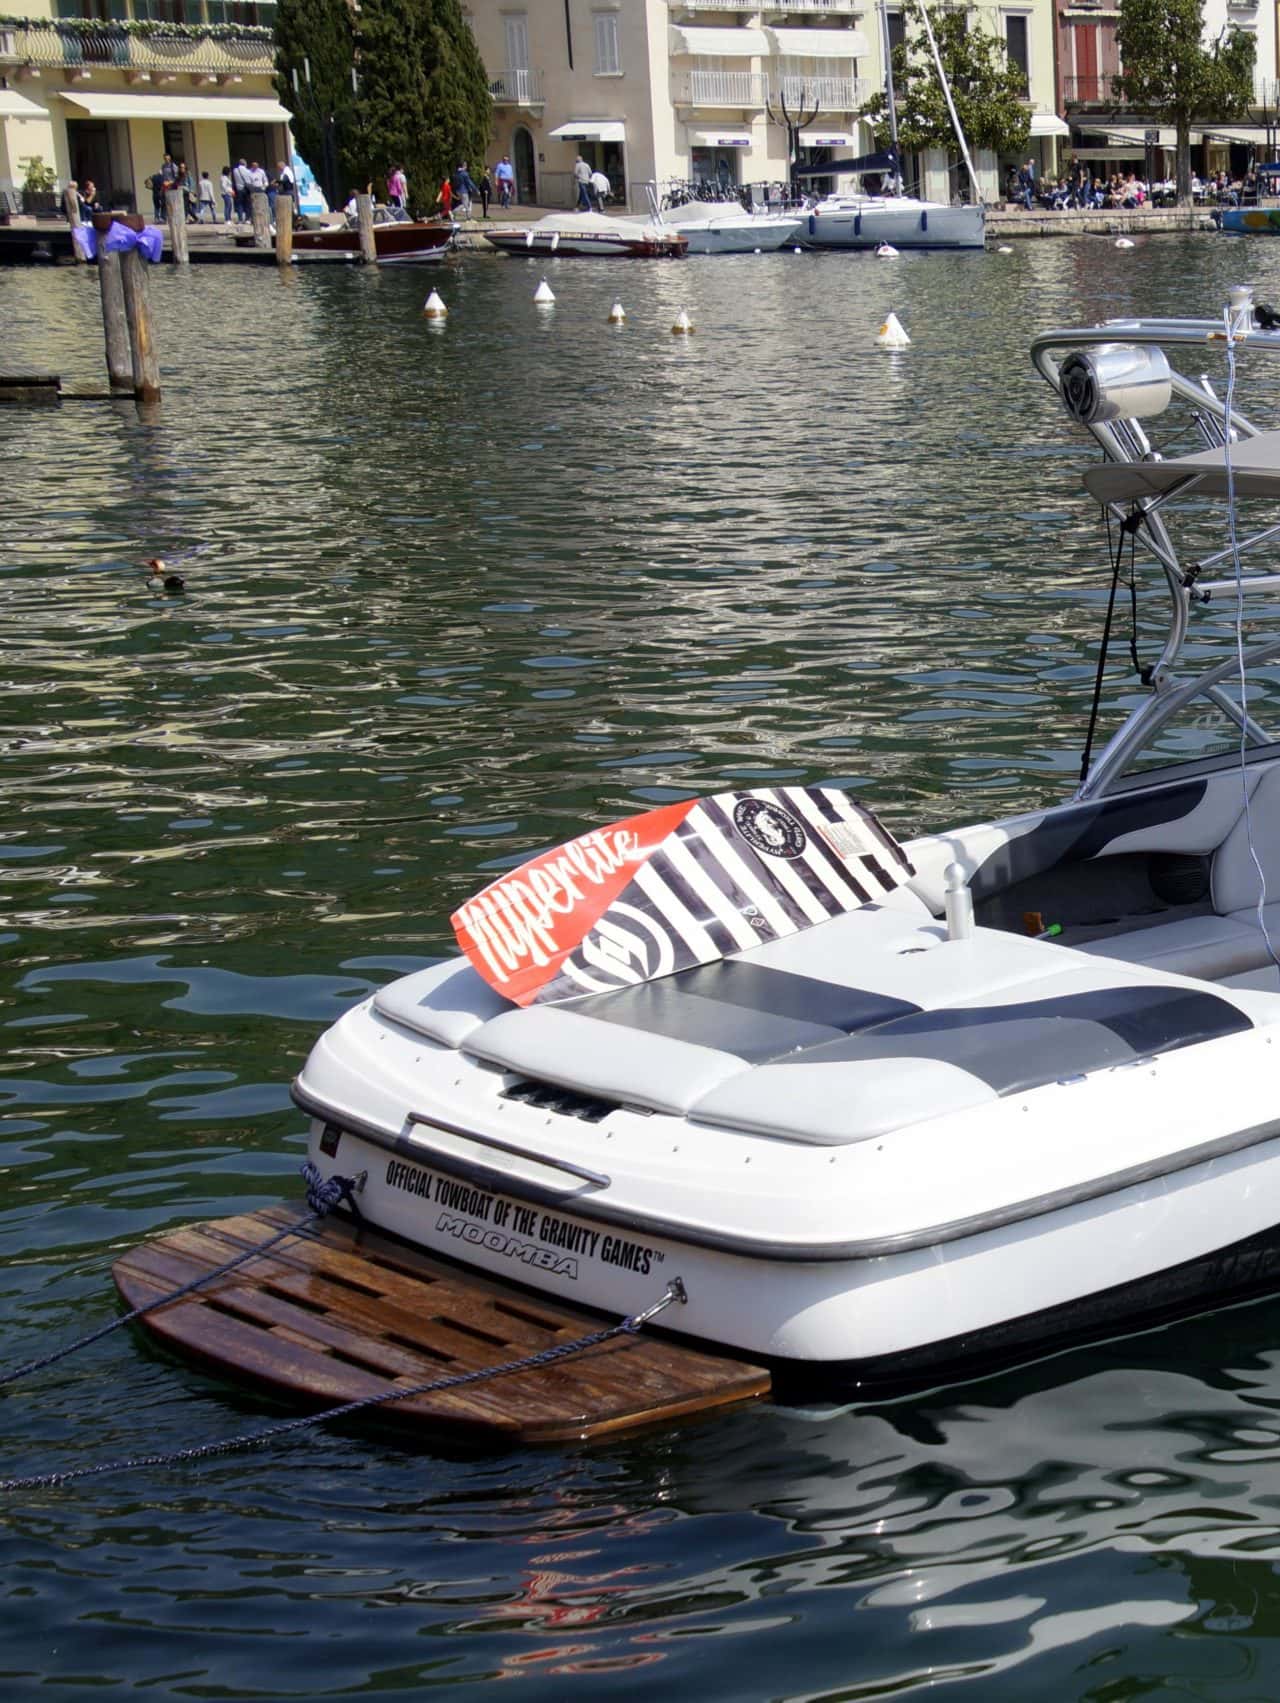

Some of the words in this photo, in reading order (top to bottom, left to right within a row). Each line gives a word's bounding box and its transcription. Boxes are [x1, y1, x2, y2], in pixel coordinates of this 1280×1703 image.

[385, 1159, 432, 1200] OFFICIAL
[434, 1177, 495, 1221] TOWBOAT
[493, 1199, 513, 1228] OF
[512, 1205, 539, 1237] THE
[539, 1215, 601, 1258] GRAVITY
[434, 1212, 579, 1281] MOOMBA
